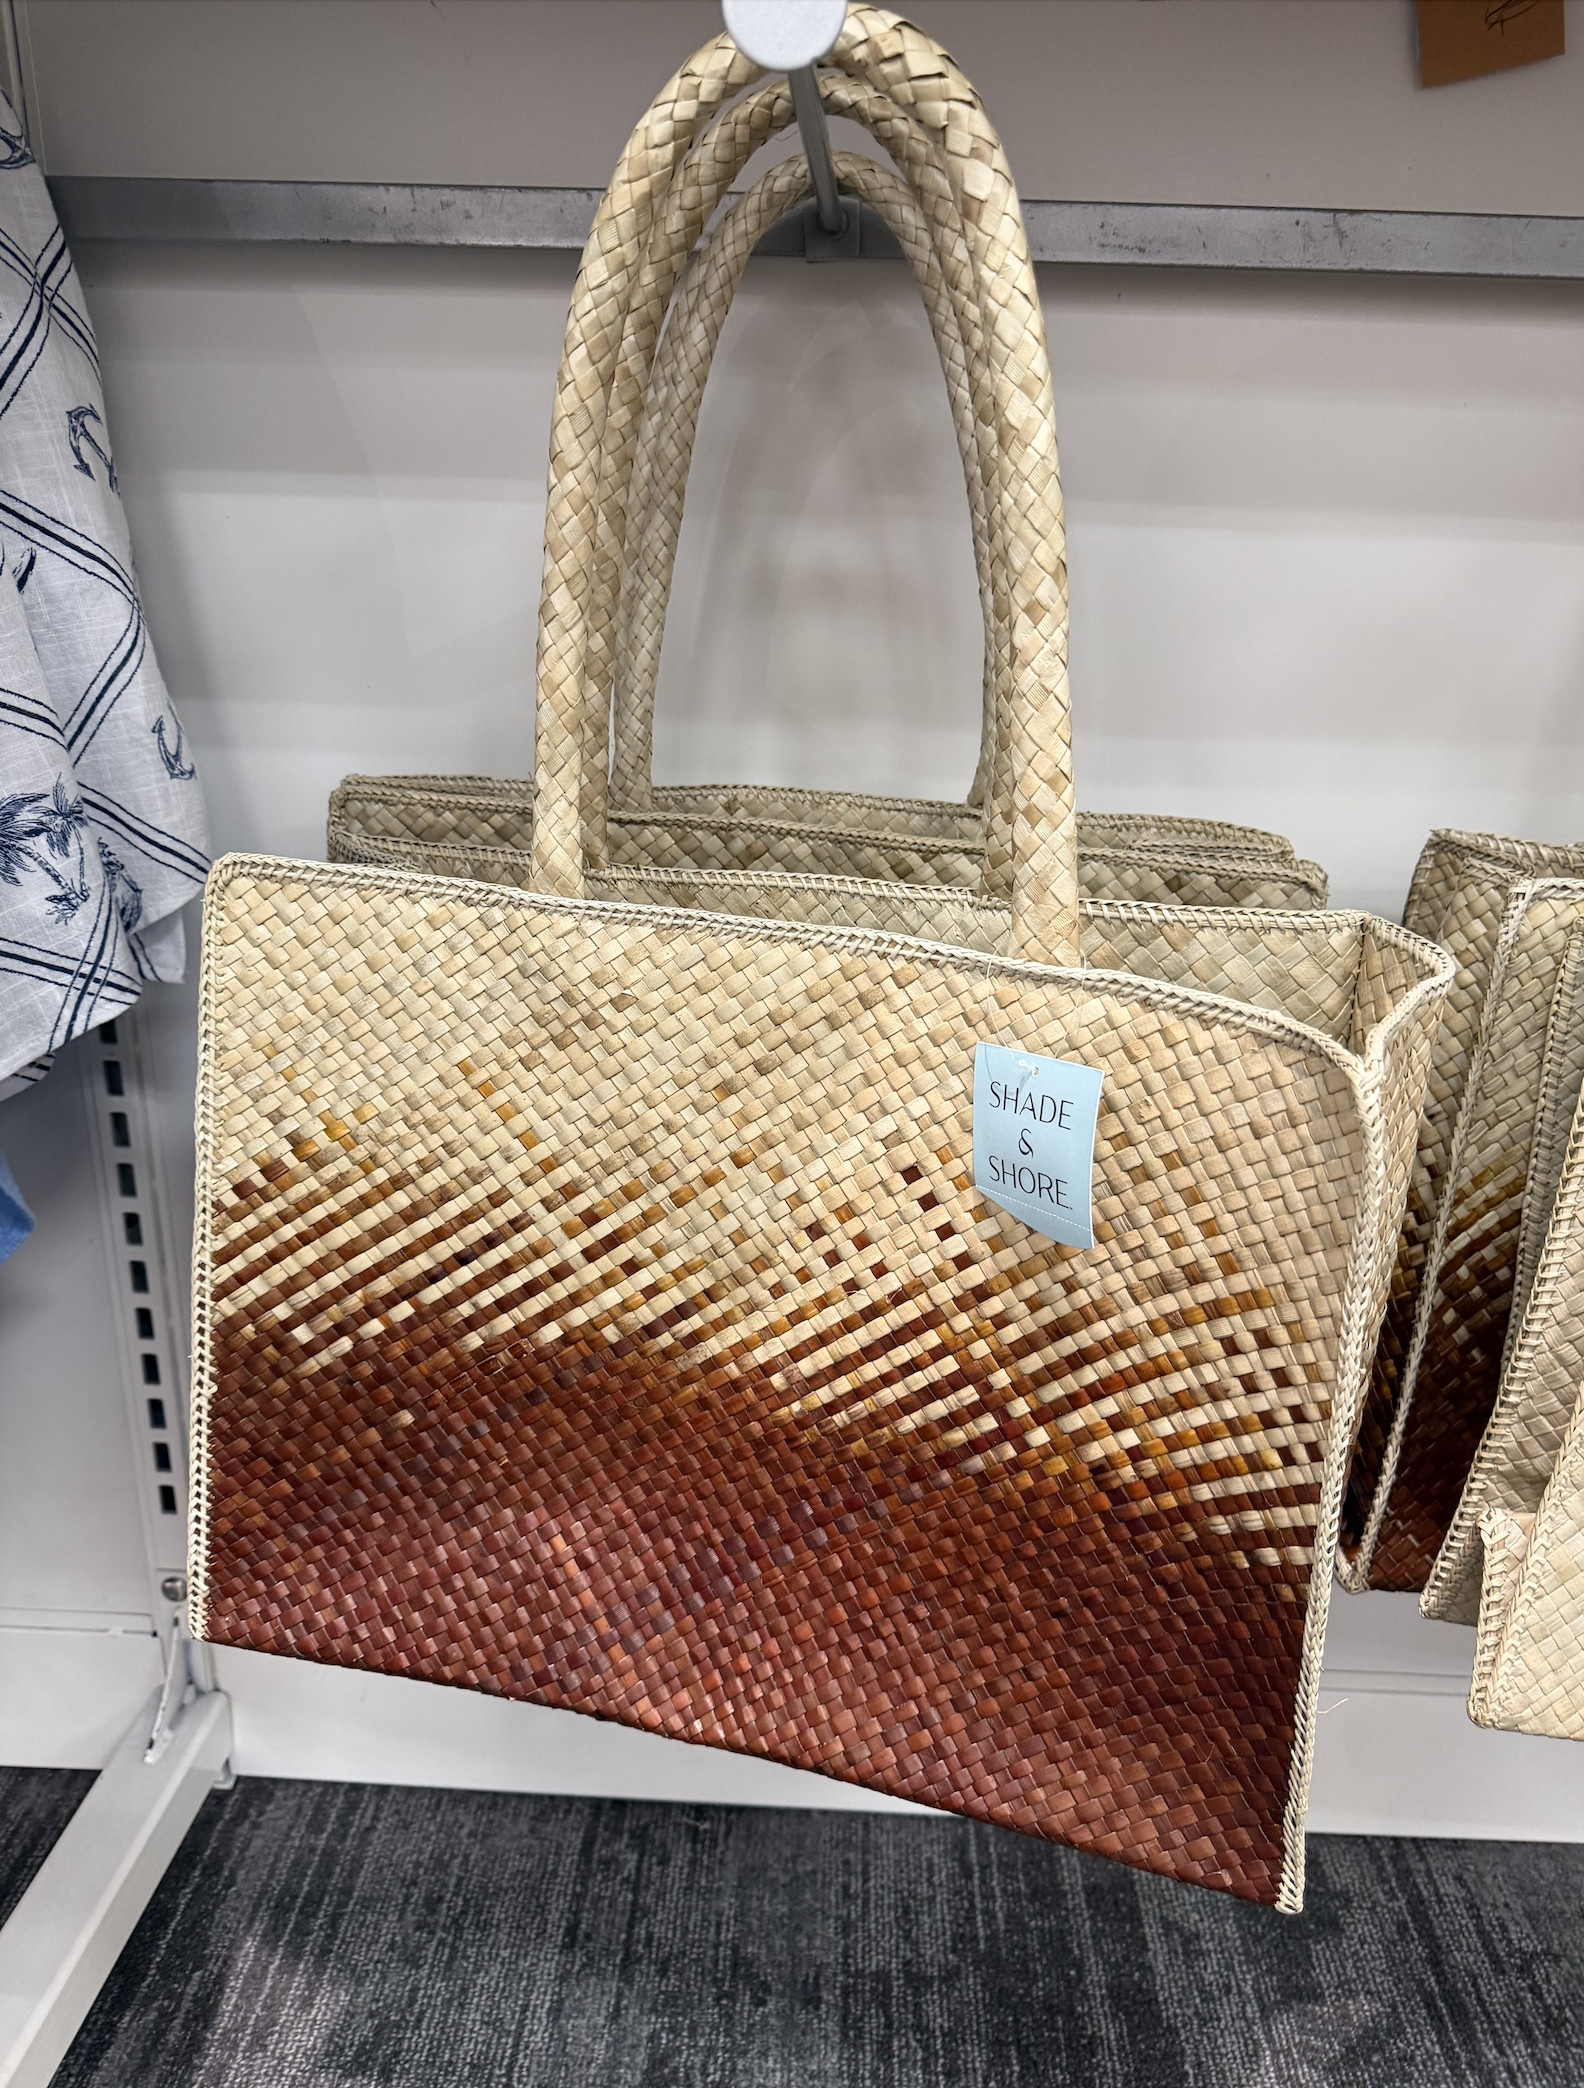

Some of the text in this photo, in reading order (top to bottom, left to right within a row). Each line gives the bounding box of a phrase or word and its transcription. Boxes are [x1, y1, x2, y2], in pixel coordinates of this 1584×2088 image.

[989, 1081, 1074, 1131] SHADE
[1018, 1128, 1034, 1158] &
[988, 1155, 1070, 1208] SHORE
